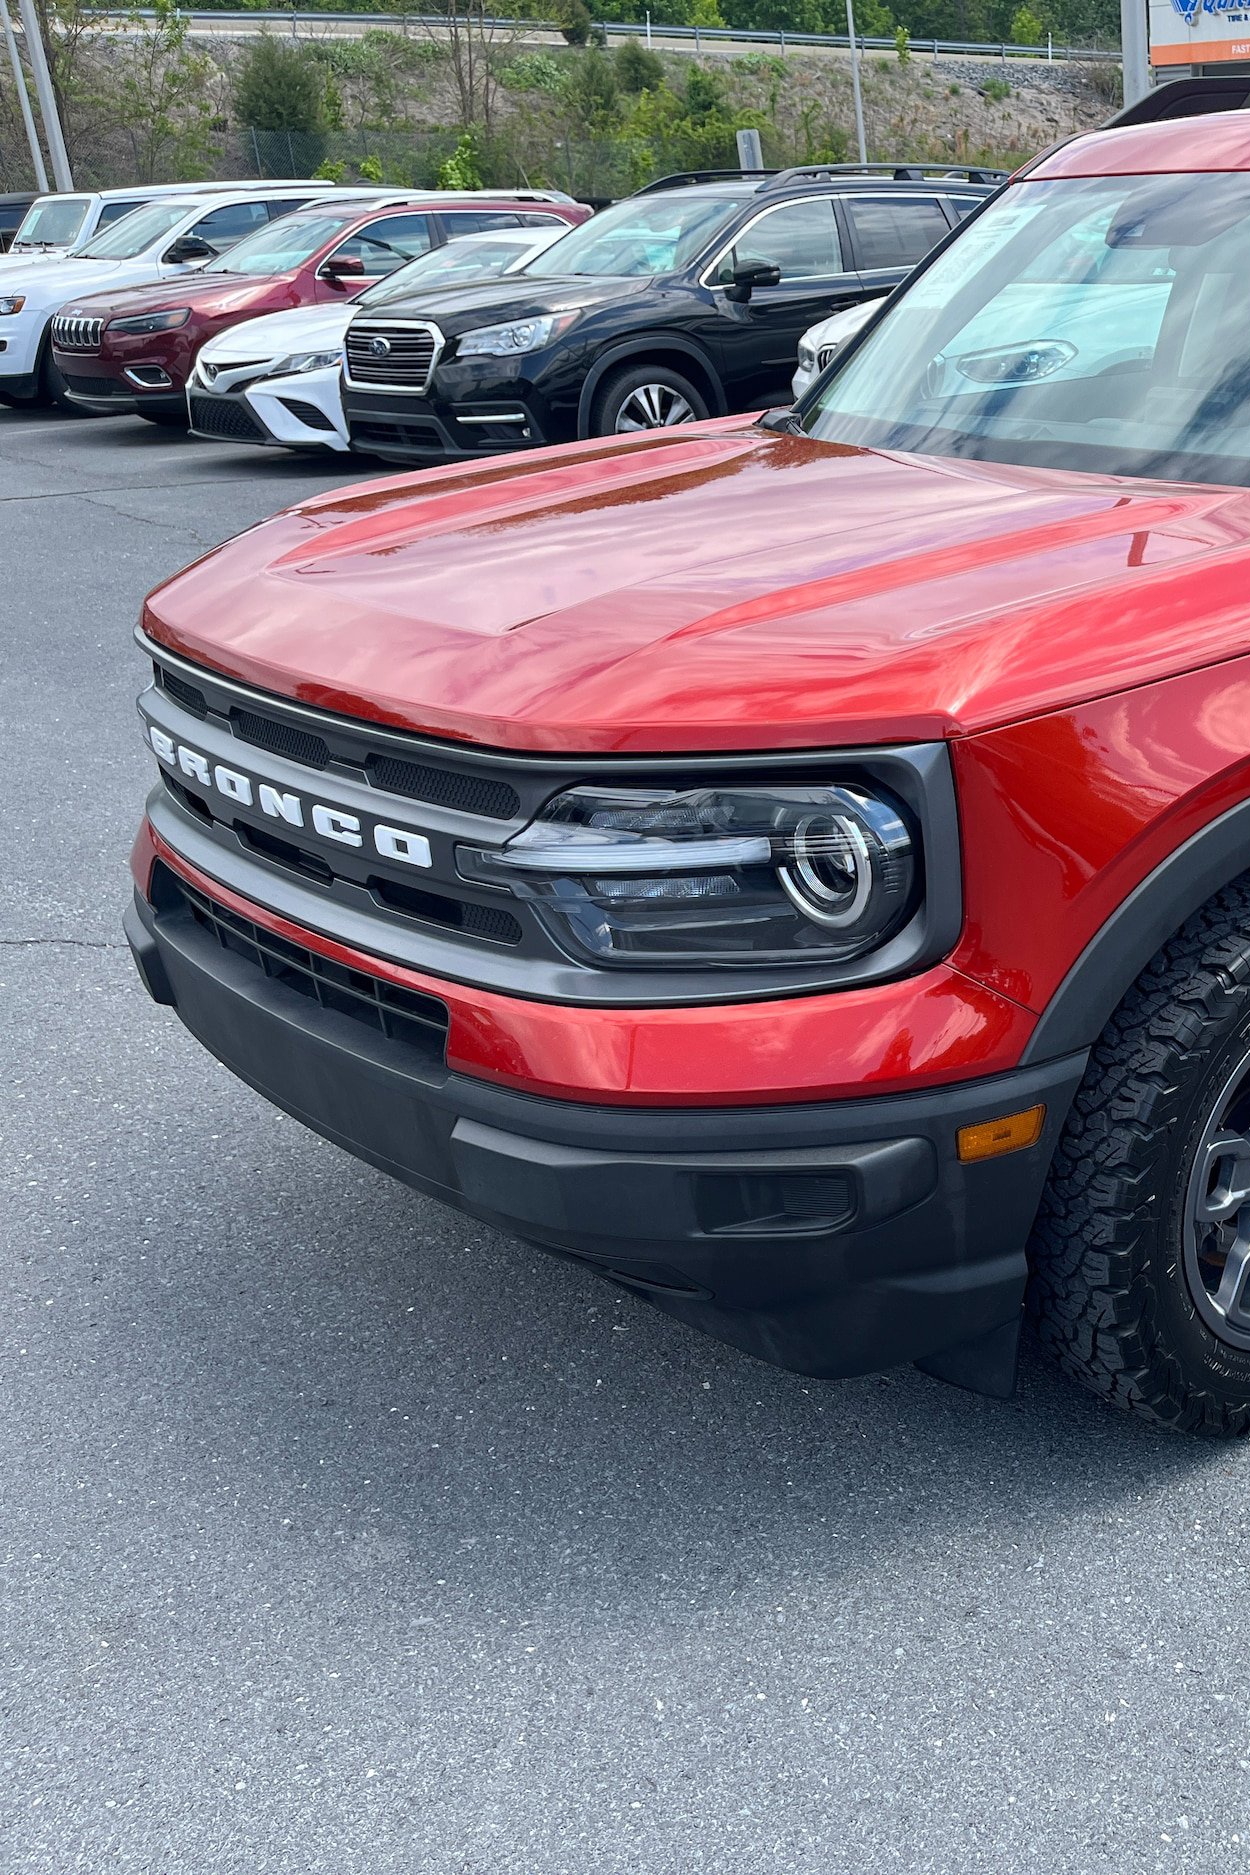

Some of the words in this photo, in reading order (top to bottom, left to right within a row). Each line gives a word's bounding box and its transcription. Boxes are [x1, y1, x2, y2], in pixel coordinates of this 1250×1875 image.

[1227, 14, 1243, 22] TIRE
[1231, 43, 1250, 54] FAST
[150, 726, 433, 868] BRONCO
